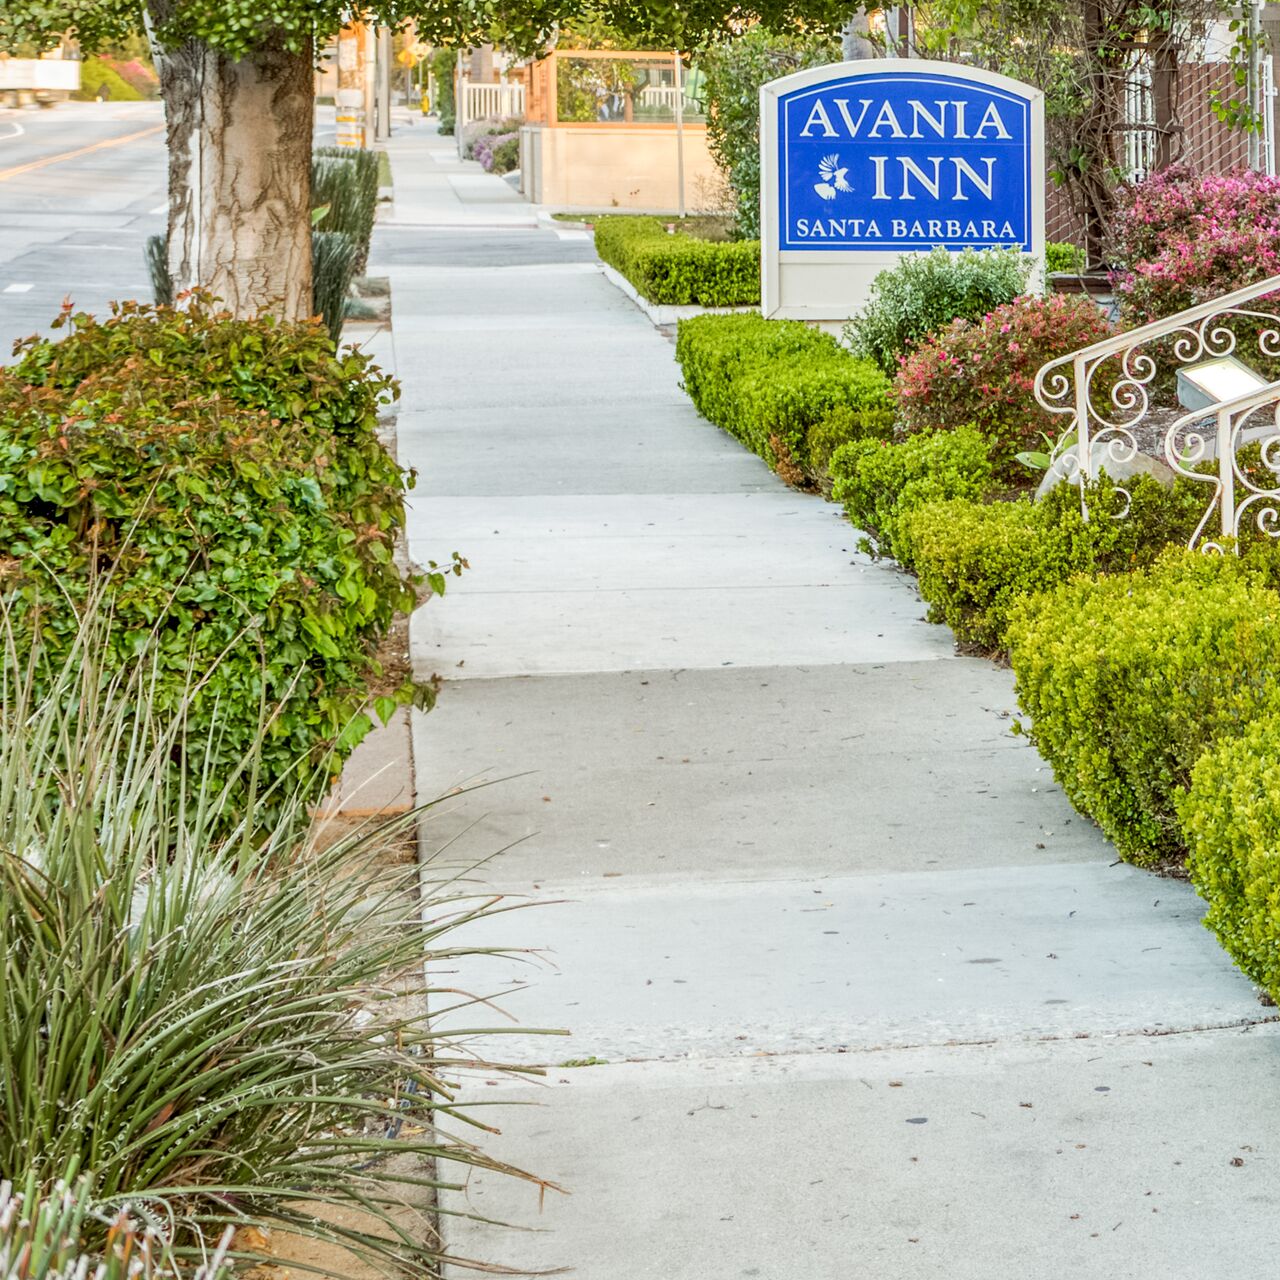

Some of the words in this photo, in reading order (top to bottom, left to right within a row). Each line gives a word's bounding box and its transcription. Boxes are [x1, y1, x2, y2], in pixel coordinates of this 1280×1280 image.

[799, 98, 1013, 140] AVANIA
[868, 156, 997, 201] INN
[796, 219, 882, 238] SANTA
[891, 220, 1016, 238] BARBARA
